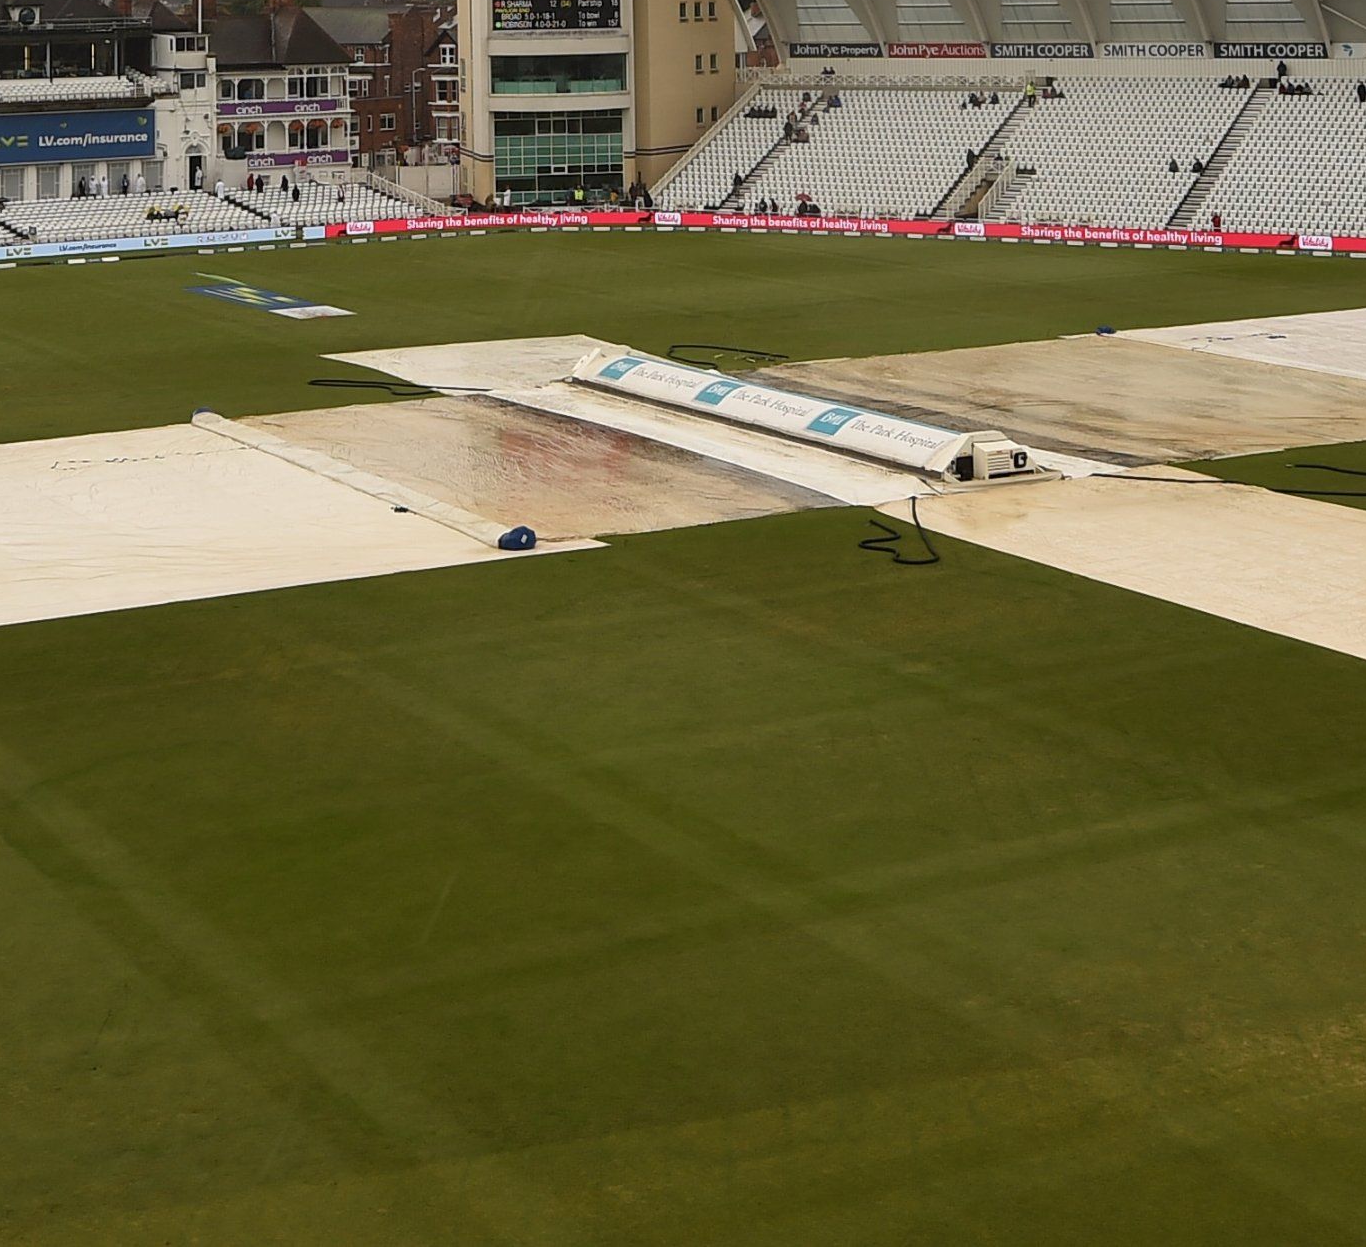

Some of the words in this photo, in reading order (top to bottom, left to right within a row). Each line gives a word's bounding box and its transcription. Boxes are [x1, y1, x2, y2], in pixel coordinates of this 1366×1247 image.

[793, 45, 819, 55] John
[820, 45, 838, 57] Pye
[841, 47, 879, 57] Property
[890, 45, 918, 55] John
[919, 45, 938, 58] Pye
[941, 45, 984, 55] Auctions
[994, 45, 1034, 57] SMITH
[1037, 45, 1089, 57] COOPER
[1103, 45, 1146, 57] SMITH
[1148, 45, 1204, 57] COOPER
[1220, 44, 1264, 57] SMITH
[1266, 44, 1324, 57] COOPER
[236, 104, 262, 114] cinch
[295, 102, 320, 112] cinch
[38, 133, 148, 148] LV.com/insurance
[249, 156, 274, 166] cinch
[307, 153, 332, 163] cinch
[407, 220, 443, 229] Sharing
[446, 218, 461, 227] the
[464, 215, 504, 226] benefits
[507, 214, 517, 224] of
[520, 213, 558, 226] healthy
[561, 213, 587, 225] living
[713, 215, 748, 227] Sharing
[751, 217, 766, 226] the
[768, 217, 808, 228] benefits
[810, 219, 821, 228] of
[823, 219, 858, 231] healthy
[860, 220, 888, 231] living
[1021, 226, 1061, 239] Sharing
[1063, 228, 1082, 237] the
[1085, 229, 1130, 240] benefits
[1132, 229, 1145, 241] of
[1147, 231, 1187, 244] healthy
[1190, 232, 1223, 245] living
[733, 389, 750, 401] The
[751, 393, 771, 407] Park
[771, 398, 811, 418] Hospital
[851, 419, 870, 432] The
[871, 423, 894, 438] Park
[895, 430, 945, 451] Hospital
